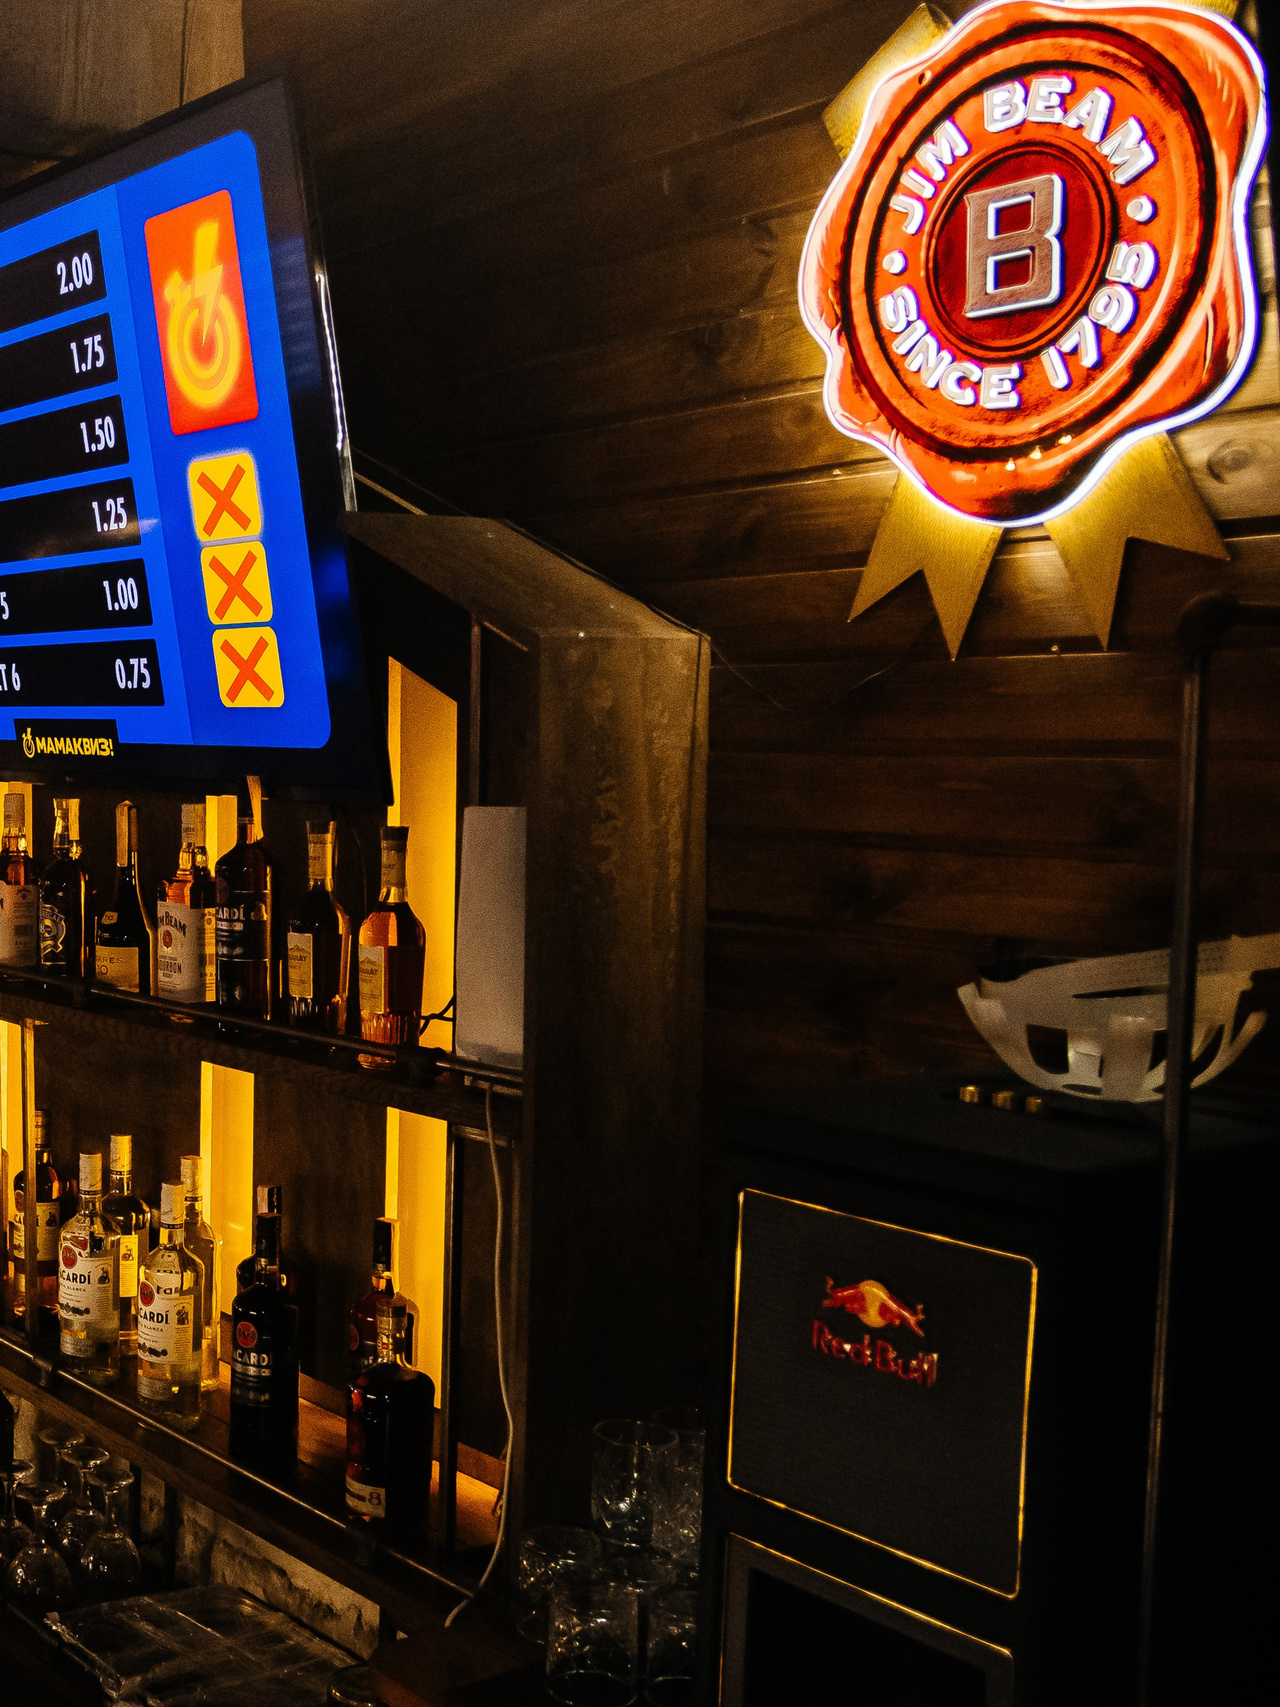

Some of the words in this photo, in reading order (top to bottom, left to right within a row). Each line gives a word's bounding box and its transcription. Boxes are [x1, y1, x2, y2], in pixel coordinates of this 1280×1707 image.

[888, 117, 972, 236] JIM
[983, 75, 1157, 185] BEAM
[963, 173, 1063, 320] B
[56, 252, 94, 295] 2.00
[879, 285, 1021, 410] SINCE
[1039, 240, 1157, 390] 1795
[70, 334, 105, 374] 1.75
[80, 415, 116, 453] 1.50
[92, 497, 129, 533] 1.25
[0, 591, 10, 620] 5
[103, 577, 139, 611] 1.00
[11, 663, 21, 691] 6
[114, 657, 151, 689] 0.75
[35, 736, 114, 757] МАМАКВИЗ!
[812, 1320, 872, 1366] Red
[876, 1340, 939, 1388] Bull
